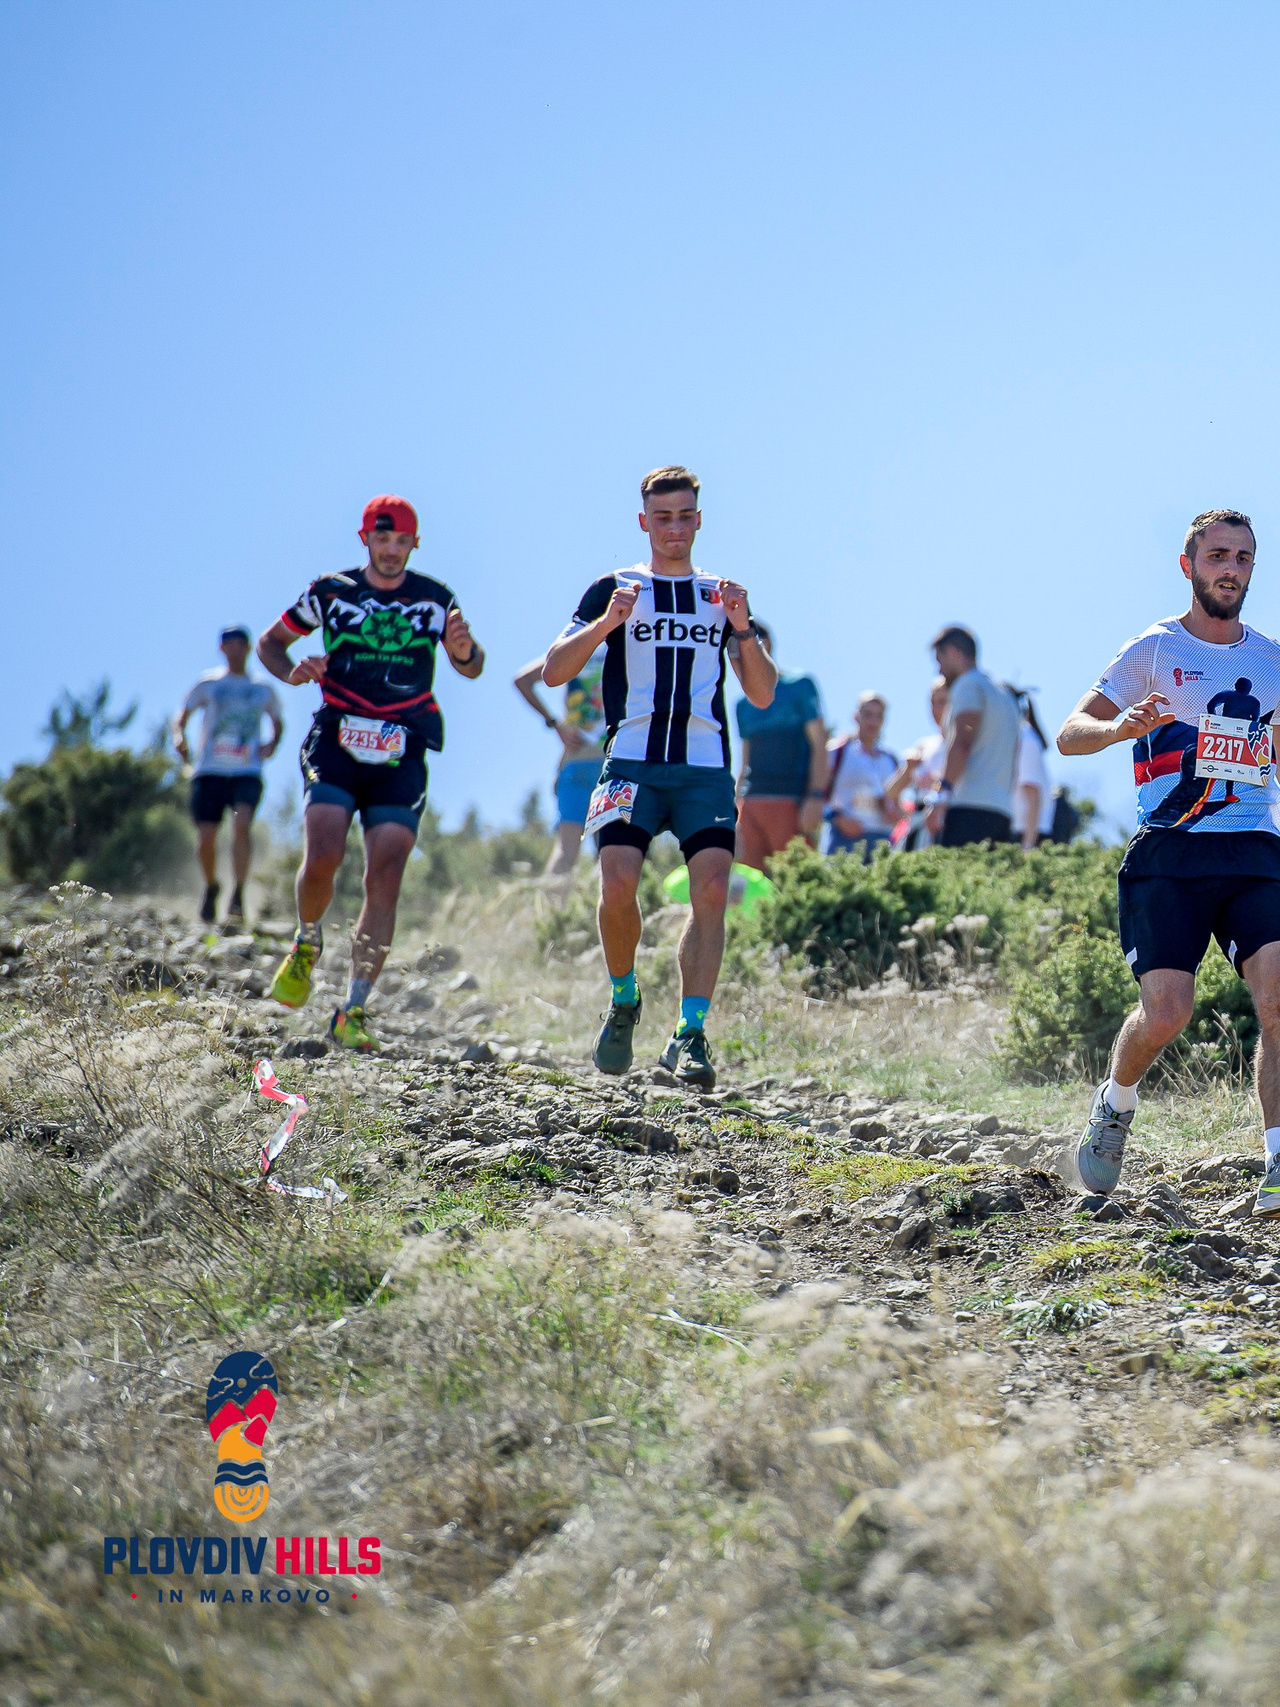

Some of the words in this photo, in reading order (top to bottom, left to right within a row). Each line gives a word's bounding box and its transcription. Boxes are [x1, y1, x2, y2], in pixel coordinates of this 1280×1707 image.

[633, 617, 722, 648] efbet
[340, 729, 380, 750] 2235
[1202, 735, 1245, 762] 2217
